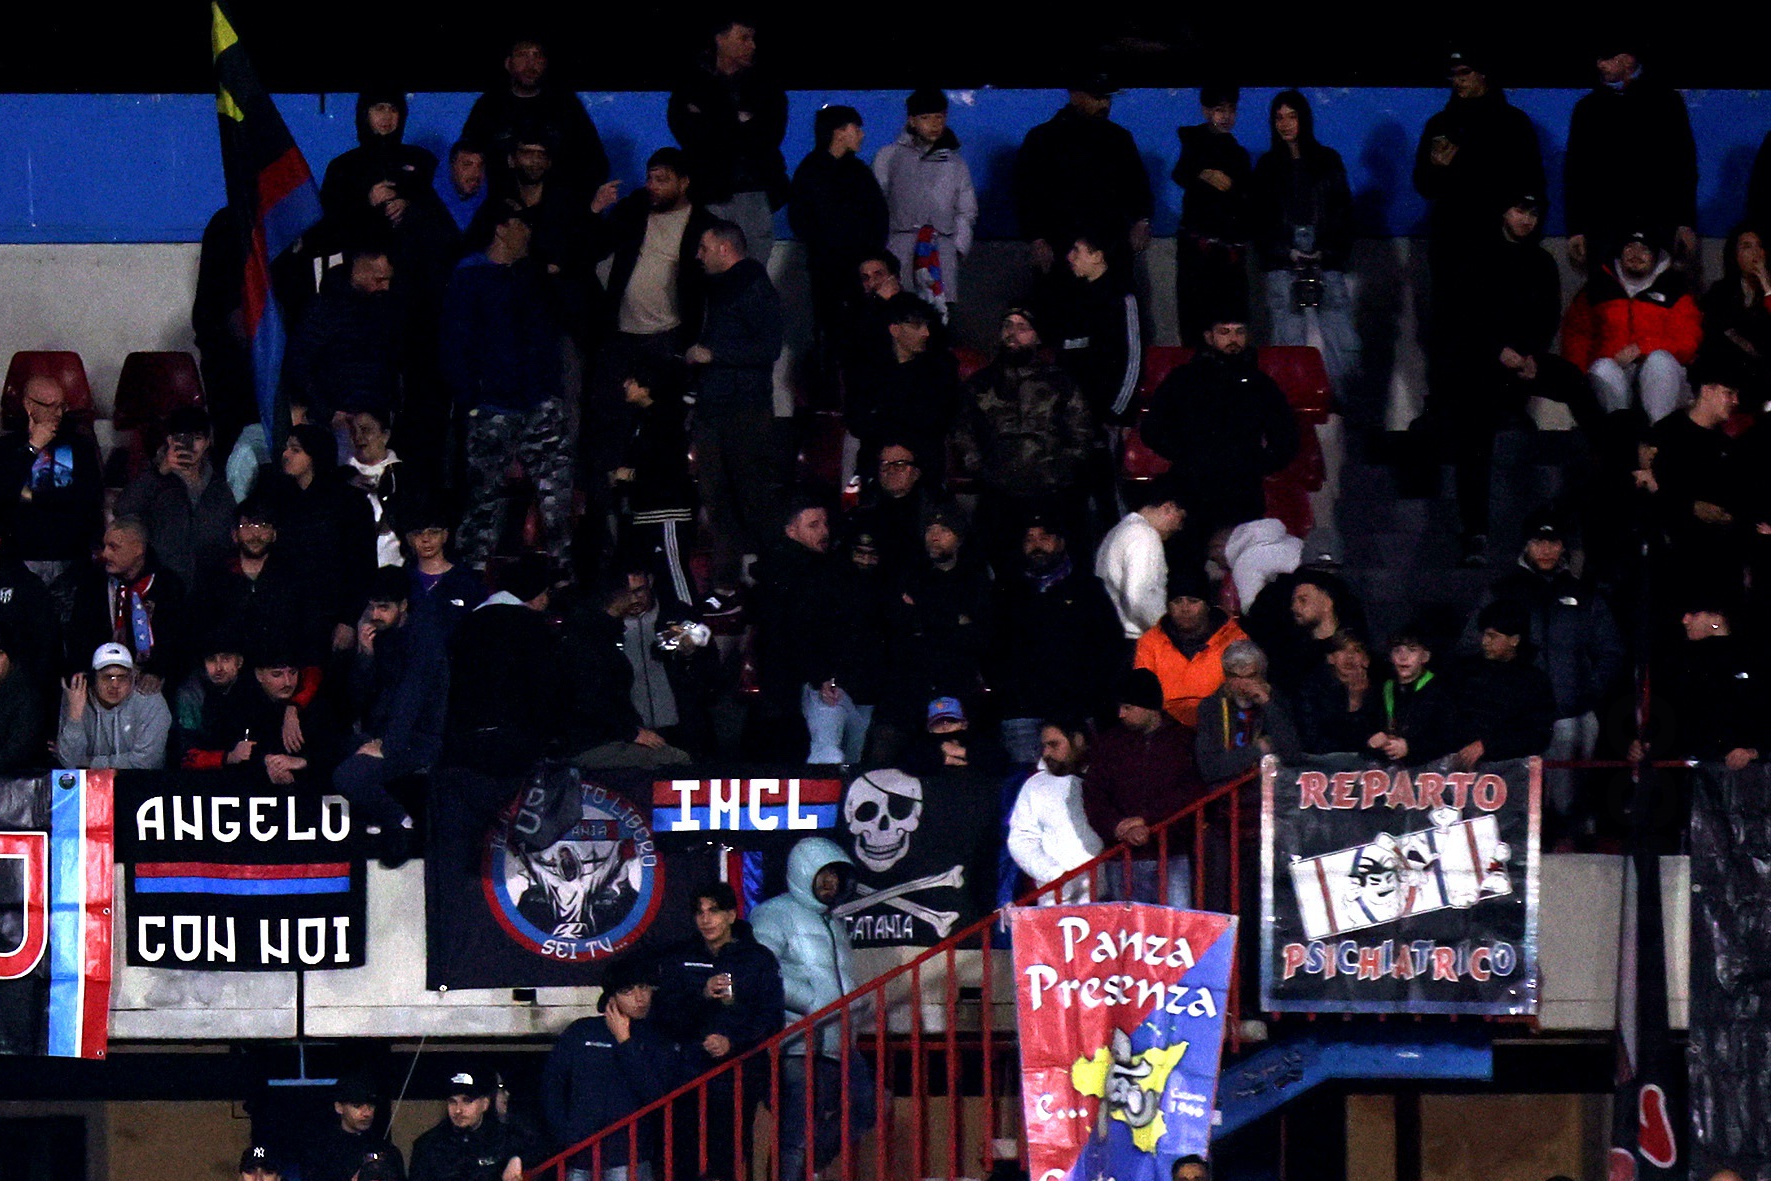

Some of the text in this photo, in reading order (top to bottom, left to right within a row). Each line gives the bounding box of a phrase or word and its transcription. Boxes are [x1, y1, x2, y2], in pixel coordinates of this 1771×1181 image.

[1296, 769, 1508, 811] REPARTO
[137, 795, 351, 843] ANGELO
[138, 915, 351, 965] CON NOI
[541, 939, 578, 960] SEI
[1057, 916, 1196, 969] Panza
[1282, 939, 1517, 983] PSICHIATRICO
